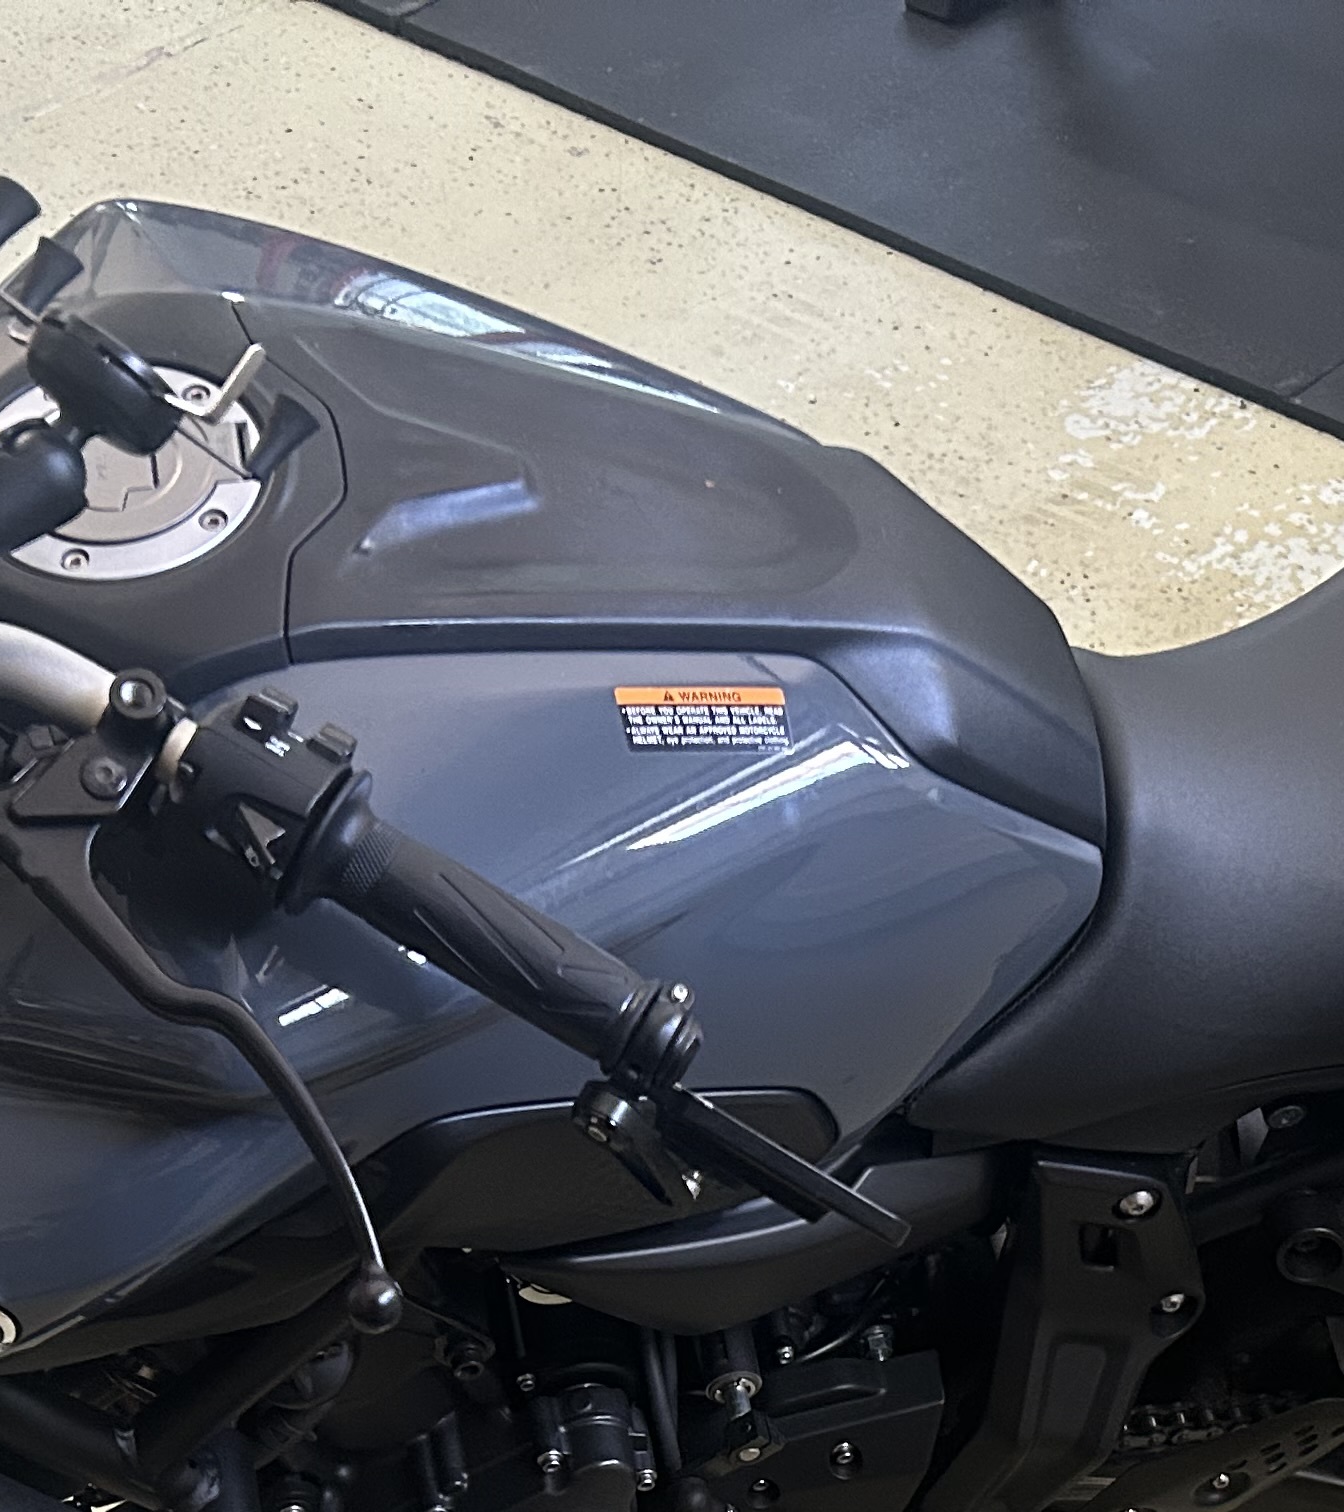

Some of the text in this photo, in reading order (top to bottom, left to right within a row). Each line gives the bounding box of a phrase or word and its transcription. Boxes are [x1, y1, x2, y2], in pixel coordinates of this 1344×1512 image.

[678, 691, 742, 703] WARNING
[658, 706, 674, 716] YOU
[676, 706, 710, 716] OPERATE
